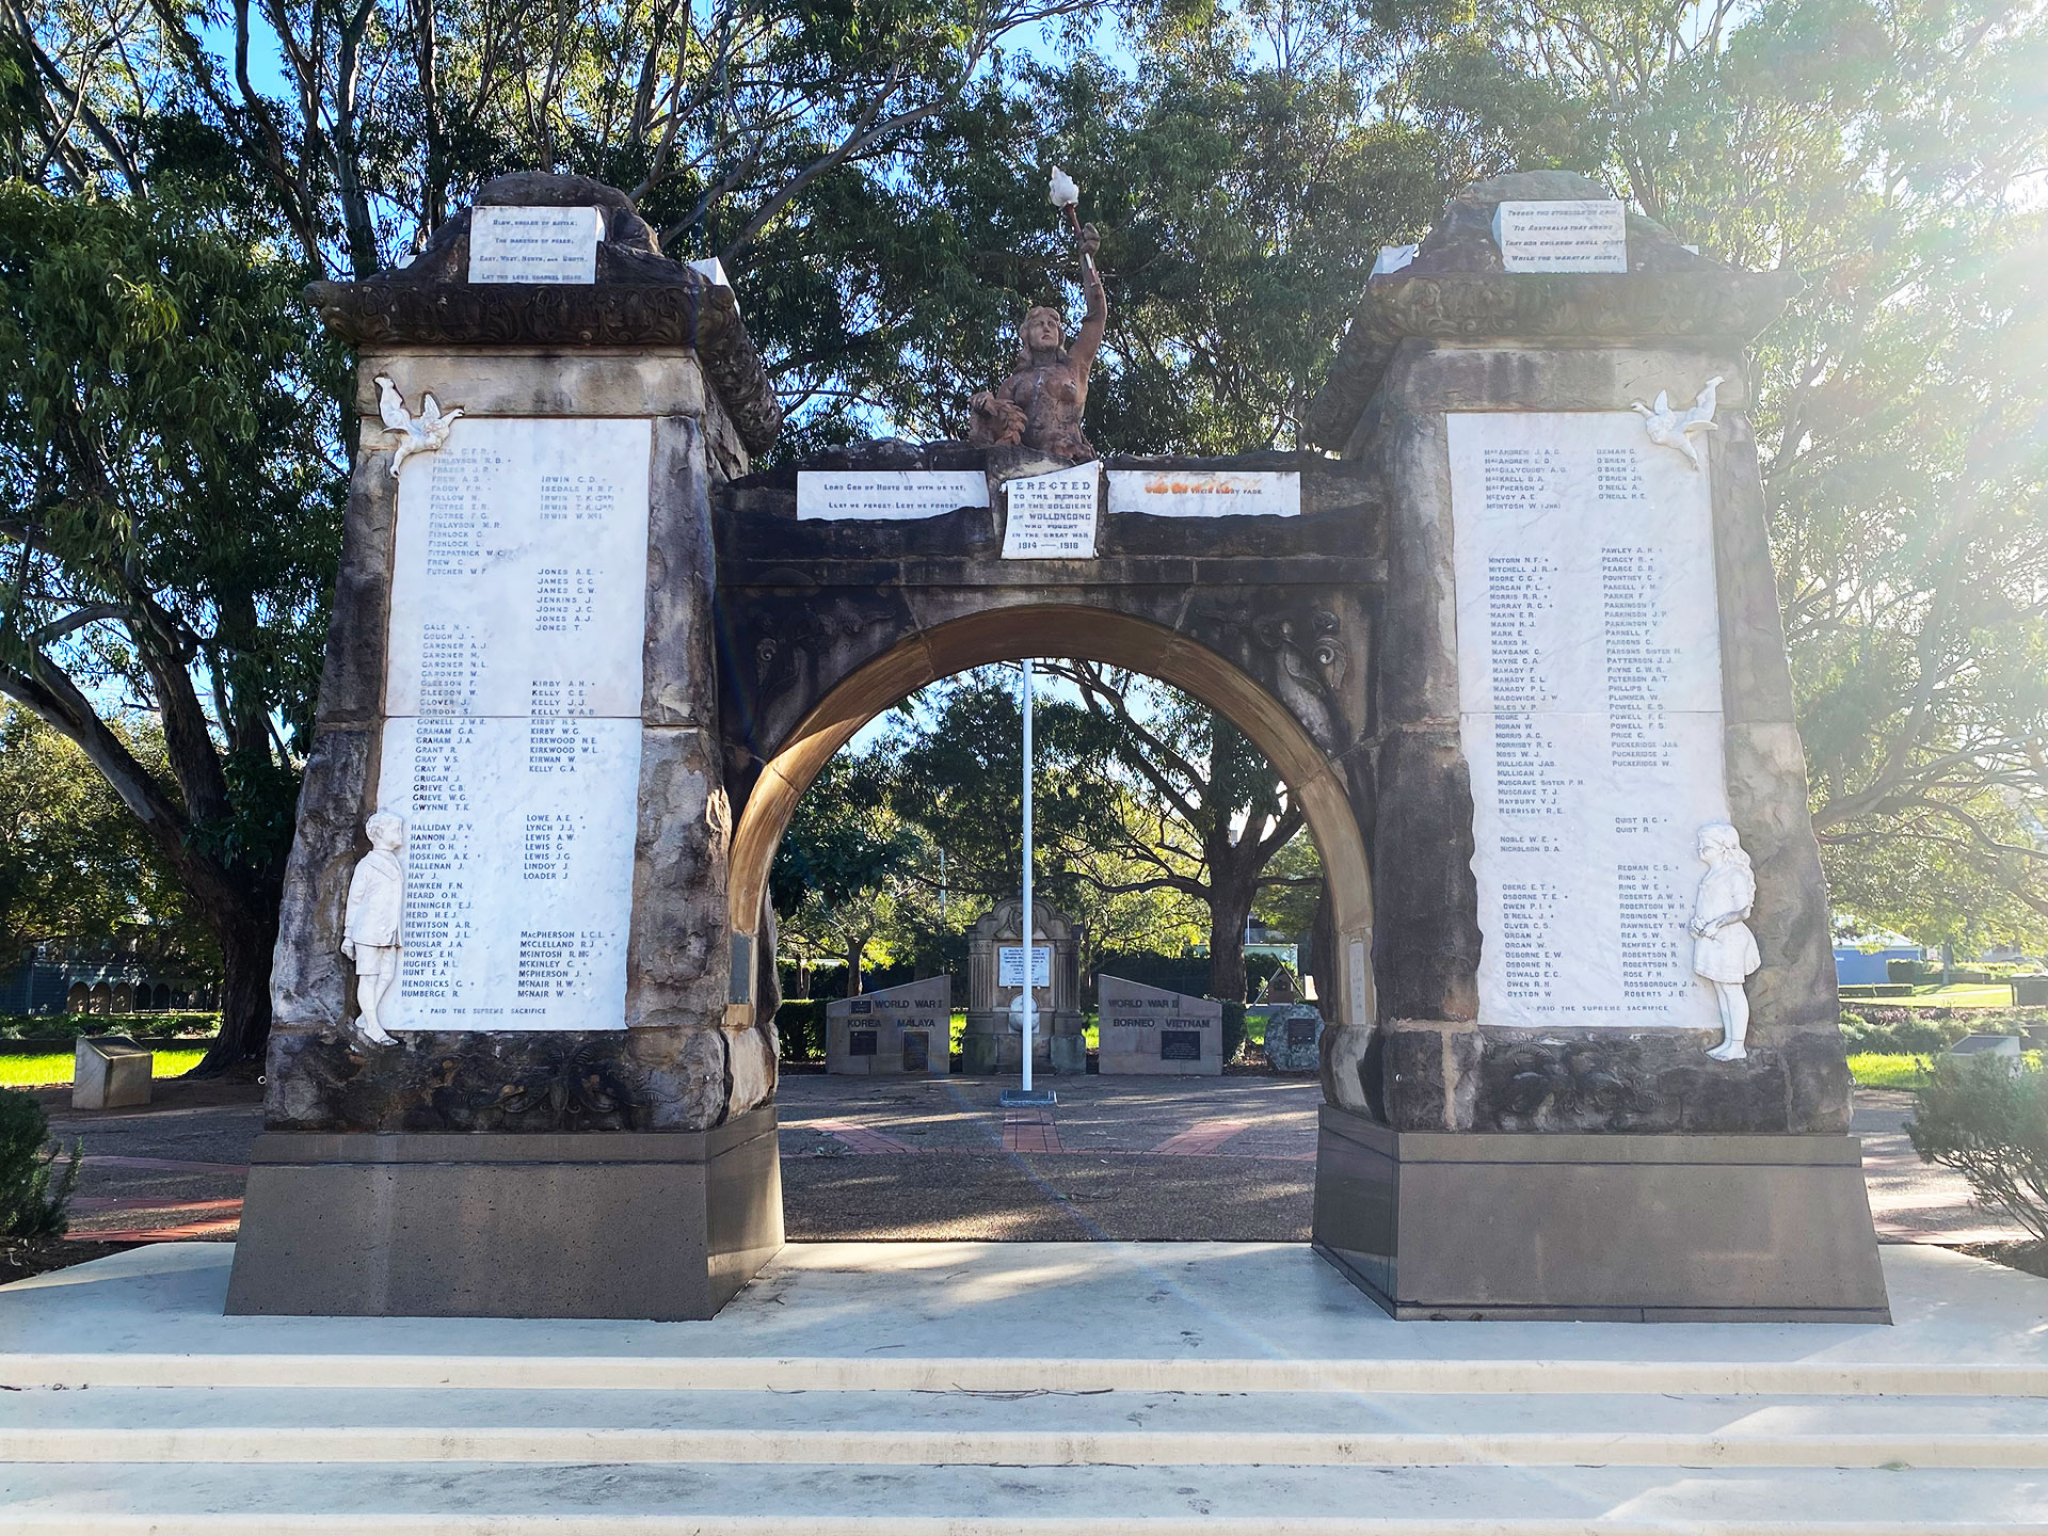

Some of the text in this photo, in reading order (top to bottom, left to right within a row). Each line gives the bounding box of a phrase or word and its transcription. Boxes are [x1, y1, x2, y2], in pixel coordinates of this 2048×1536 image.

[1016, 482, 1090, 490] ERECTED
[875, 999, 909, 1009] WORLD
[914, 999, 936, 1009] WAR
[1108, 999, 1142, 1008] WORLD
[1148, 999, 1169, 1008] WAR
[848, 1018, 935, 1028] KOREA MALAYA
[1113, 1018, 1210, 1028] BORNEO VIETNAM
